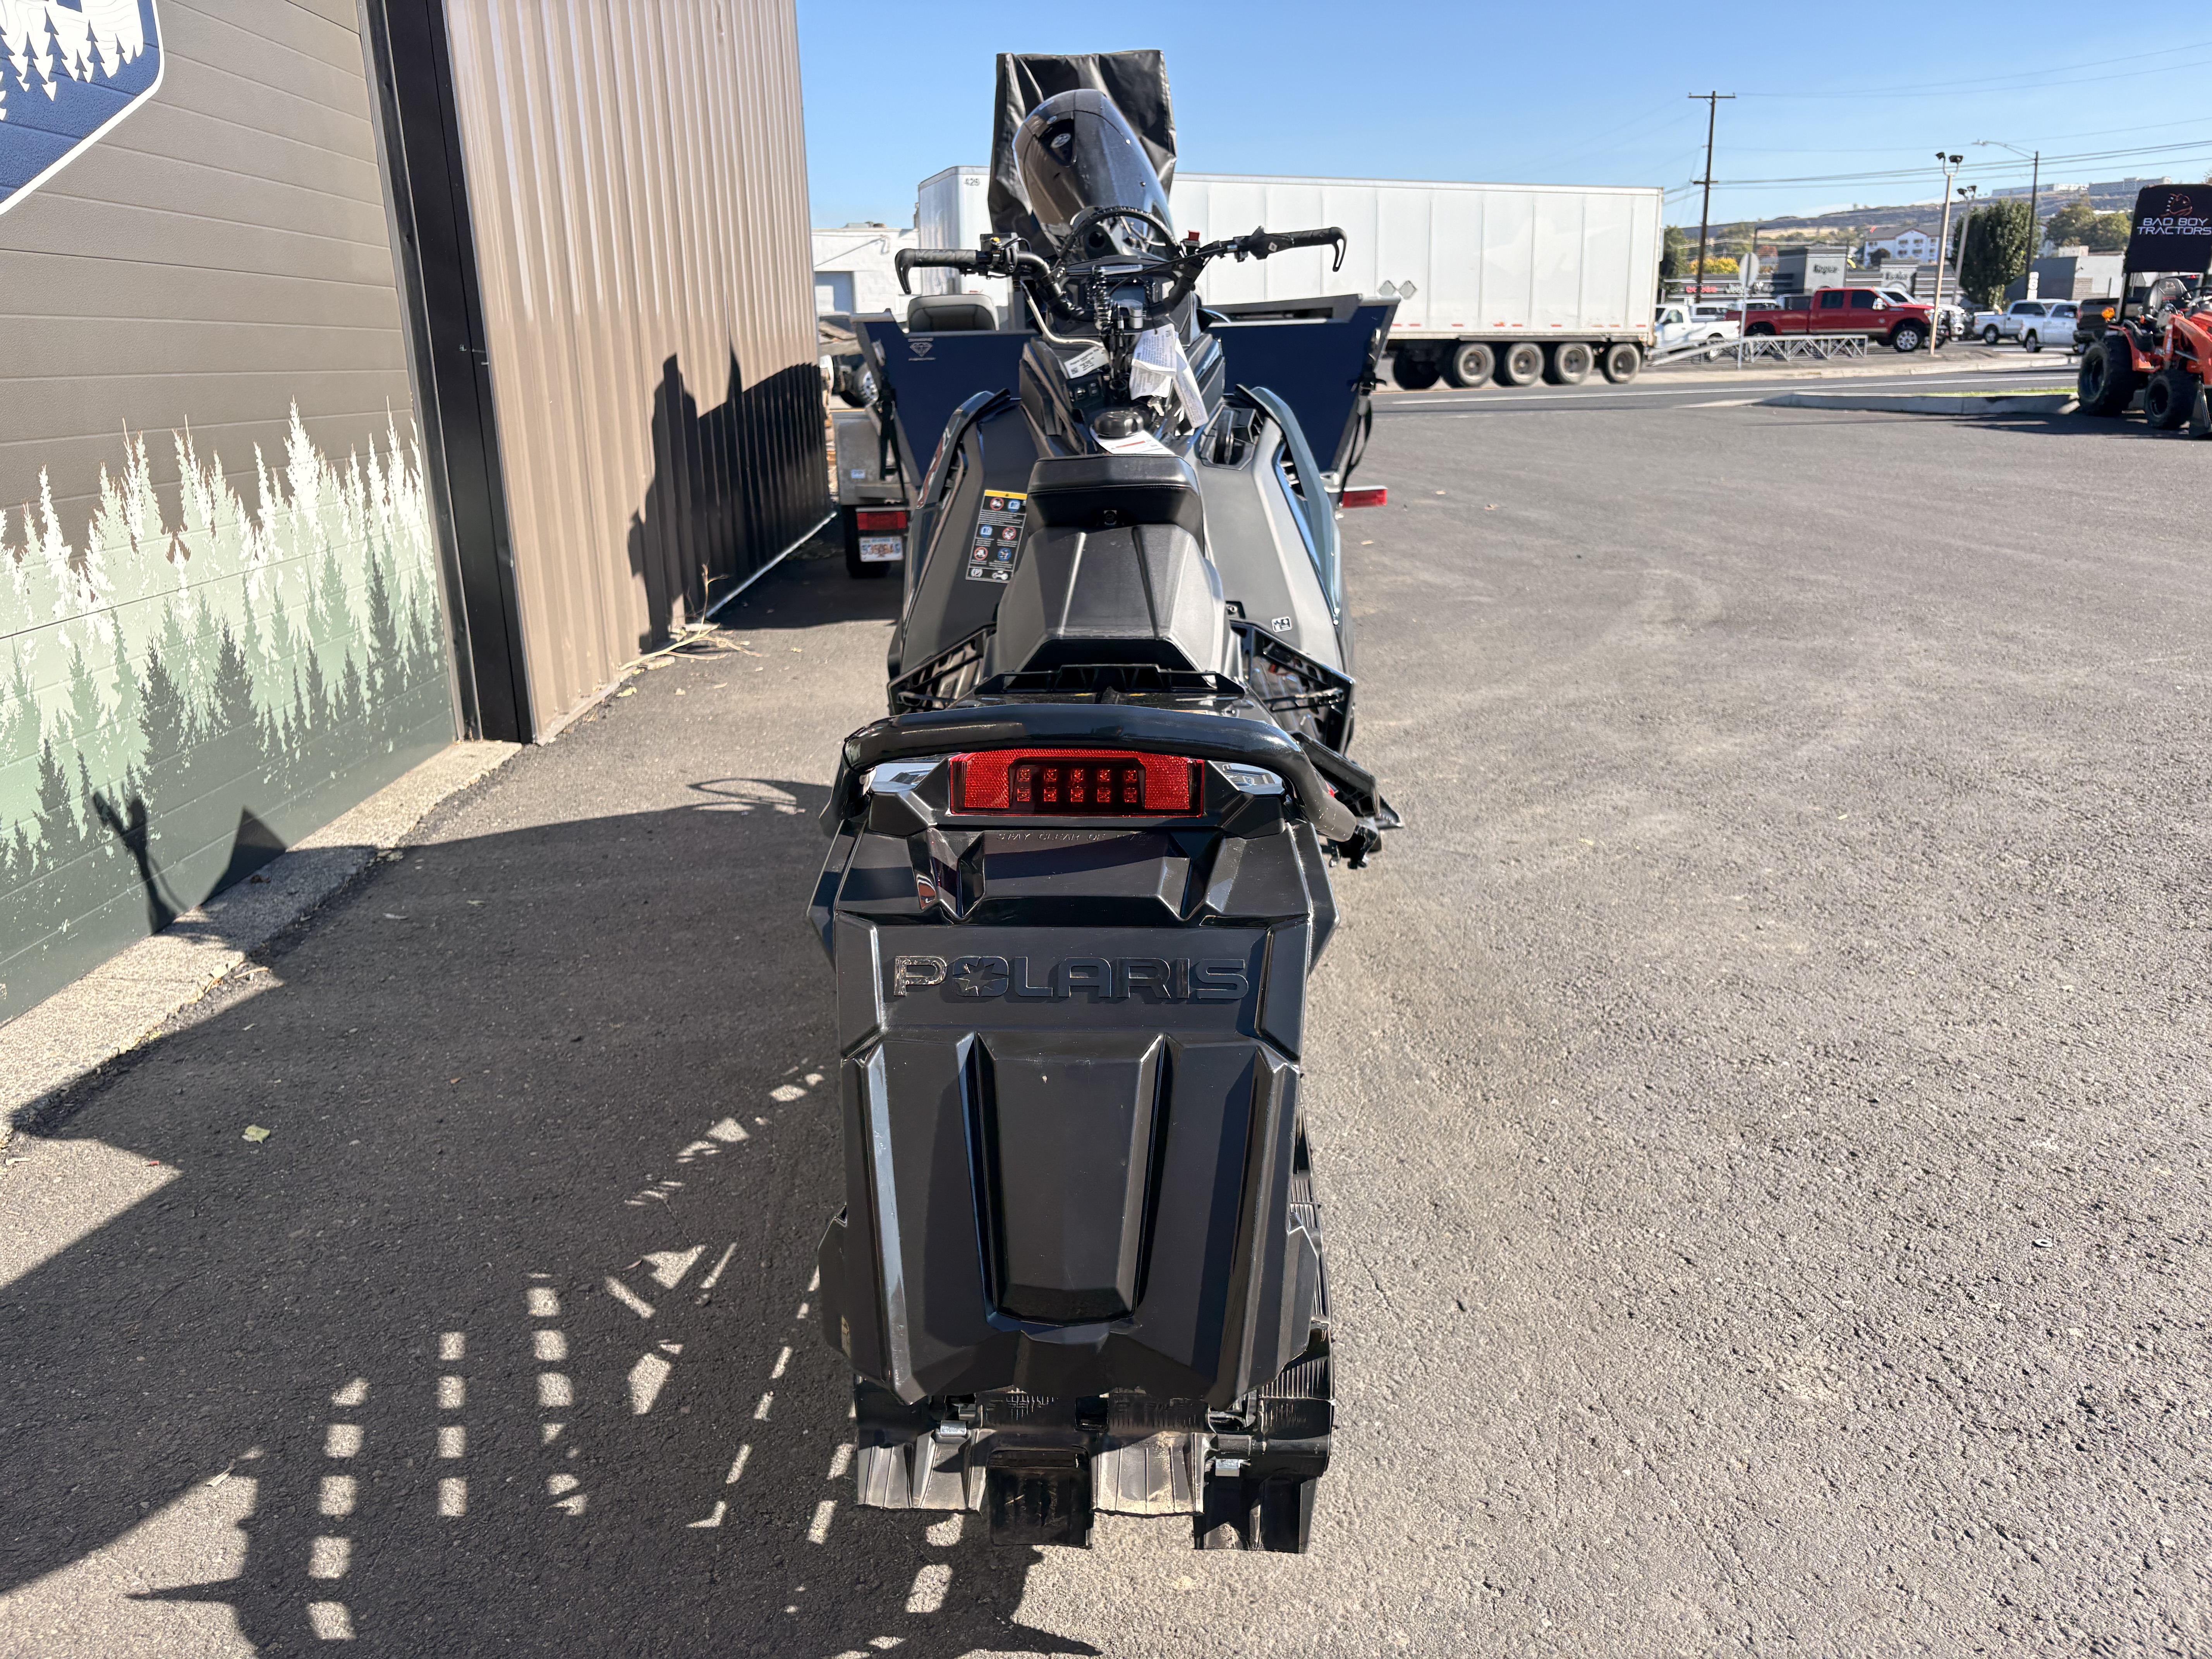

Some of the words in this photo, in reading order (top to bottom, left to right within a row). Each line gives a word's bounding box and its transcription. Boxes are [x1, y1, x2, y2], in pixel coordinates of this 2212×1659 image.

[2143, 218, 2173, 226] BAD
[2178, 218, 2209, 226] BOY
[2137, 227, 2212, 235] TRACTORS
[1038, 833, 1080, 841] CLEAR
[893, 955, 1249, 999] POLARIS
